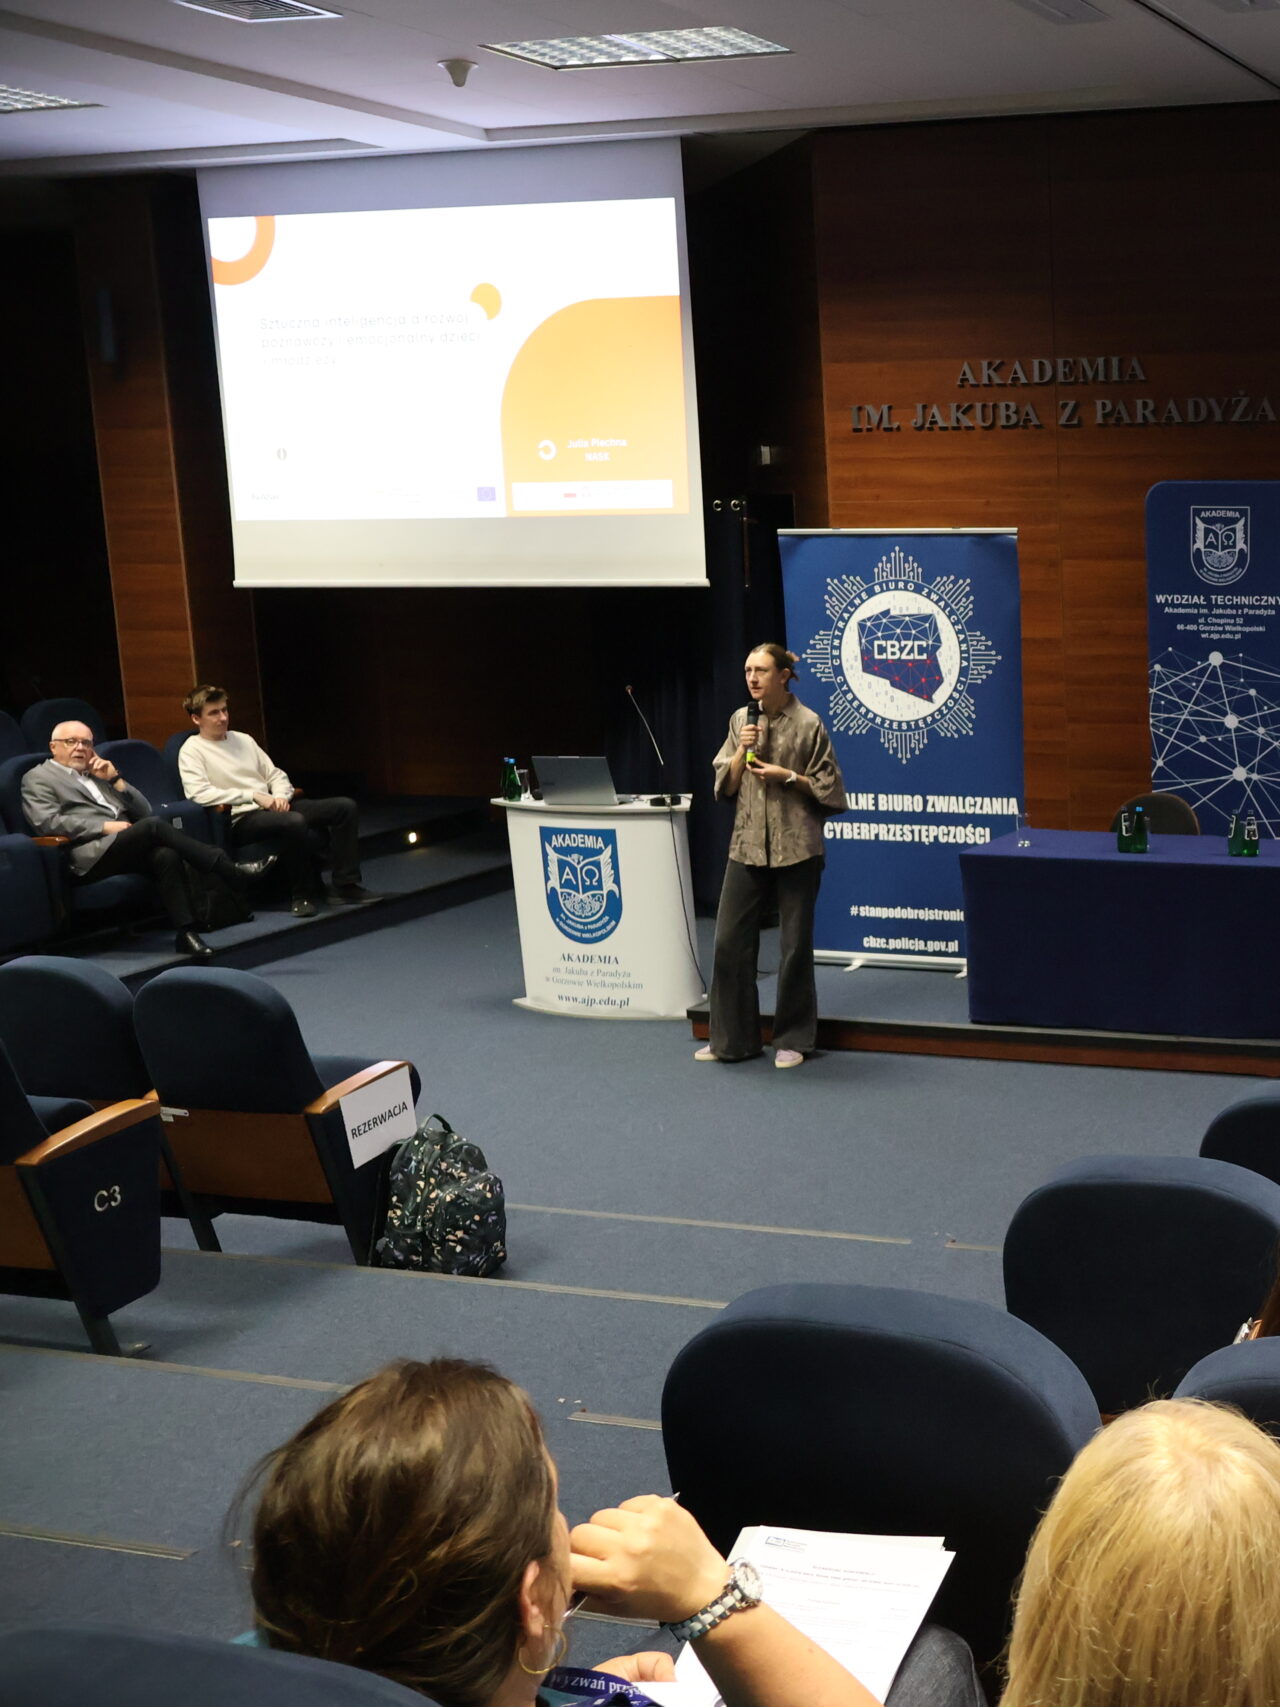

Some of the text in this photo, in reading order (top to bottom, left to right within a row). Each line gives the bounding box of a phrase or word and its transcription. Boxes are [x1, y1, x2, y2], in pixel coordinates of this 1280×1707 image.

[957, 356, 1147, 388] AKADEMIA
[849, 390, 1278, 433] IM. JAKUBA Z PARADYŻA
[1200, 510, 1240, 518] AKADEMIA
[873, 580, 915, 593] BIURO
[1155, 594, 1207, 605] WYDZIAŁ
[832, 592, 869, 665] CENTRALNE
[921, 589, 968, 667] ZWALCZANIA
[873, 640, 927, 660] CBZC
[877, 794, 924, 813] BIURO
[926, 795, 1019, 815] ZWALCZANIA
[551, 833, 605, 850] AKADEMIA
[823, 821, 991, 845] CYBERPRZESTĘPCZOŚCI
[862, 935, 959, 954] cbzc.policja.gov.pl
[560, 952, 619, 965] AKADEMIA
[557, 994, 630, 1009] www.ajp.edu.pl
[350, 1101, 408, 1140] REZERWACJA
[94, 1185, 121, 1212] C3
